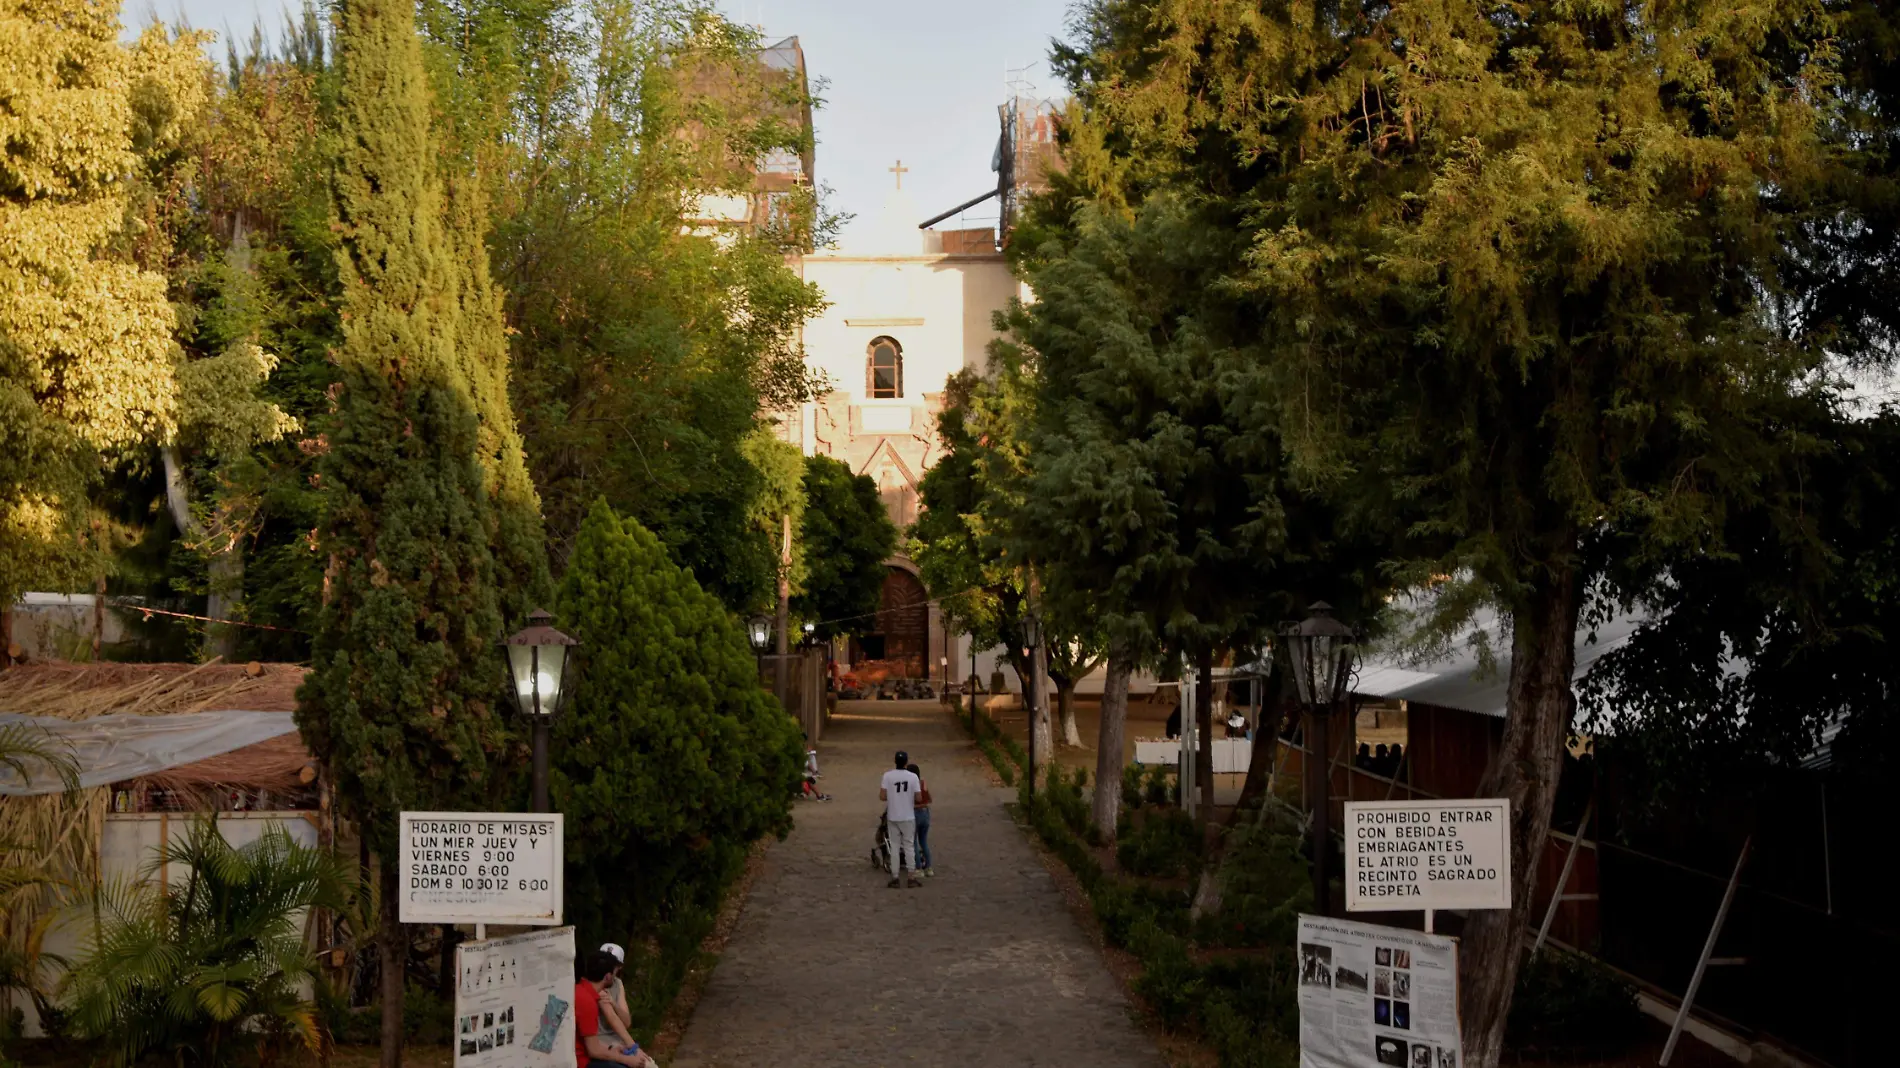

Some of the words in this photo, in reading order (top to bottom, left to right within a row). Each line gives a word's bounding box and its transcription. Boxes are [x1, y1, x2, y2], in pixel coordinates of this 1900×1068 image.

[894, 781, 909, 793] 11
[1357, 811, 1431, 824] PROHIBIDO
[1440, 811, 1493, 823] ENTRAR
[412, 822, 471, 834] HORARIO
[477, 824, 494, 834] DE
[503, 824, 553, 836] MISAS:
[1357, 827, 1386, 839] CON
[1396, 826, 1457, 838] BEBIDAS
[412, 837, 438, 848] LUN
[443, 837, 475, 849] MIER
[482, 838, 518, 849] JUEV
[530, 838, 538, 849] Y
[1358, 840, 1464, 853] EMBRIAGANTES
[412, 850, 470, 862] VIERNES
[484, 851, 515, 862] 9:00
[1358, 856, 1374, 868] EL
[1380, 856, 1419, 867] ATRIO
[1429, 855, 1446, 866] ES
[1454, 854, 1472, 866] UN
[411, 864, 467, 875] SABADO
[1358, 870, 1417, 882] RECINTO
[1428, 868, 1496, 881] SAGRADO
[411, 878, 440, 889] DOM
[445, 878, 453, 889] 8
[1359, 884, 1421, 896] RESPETA
